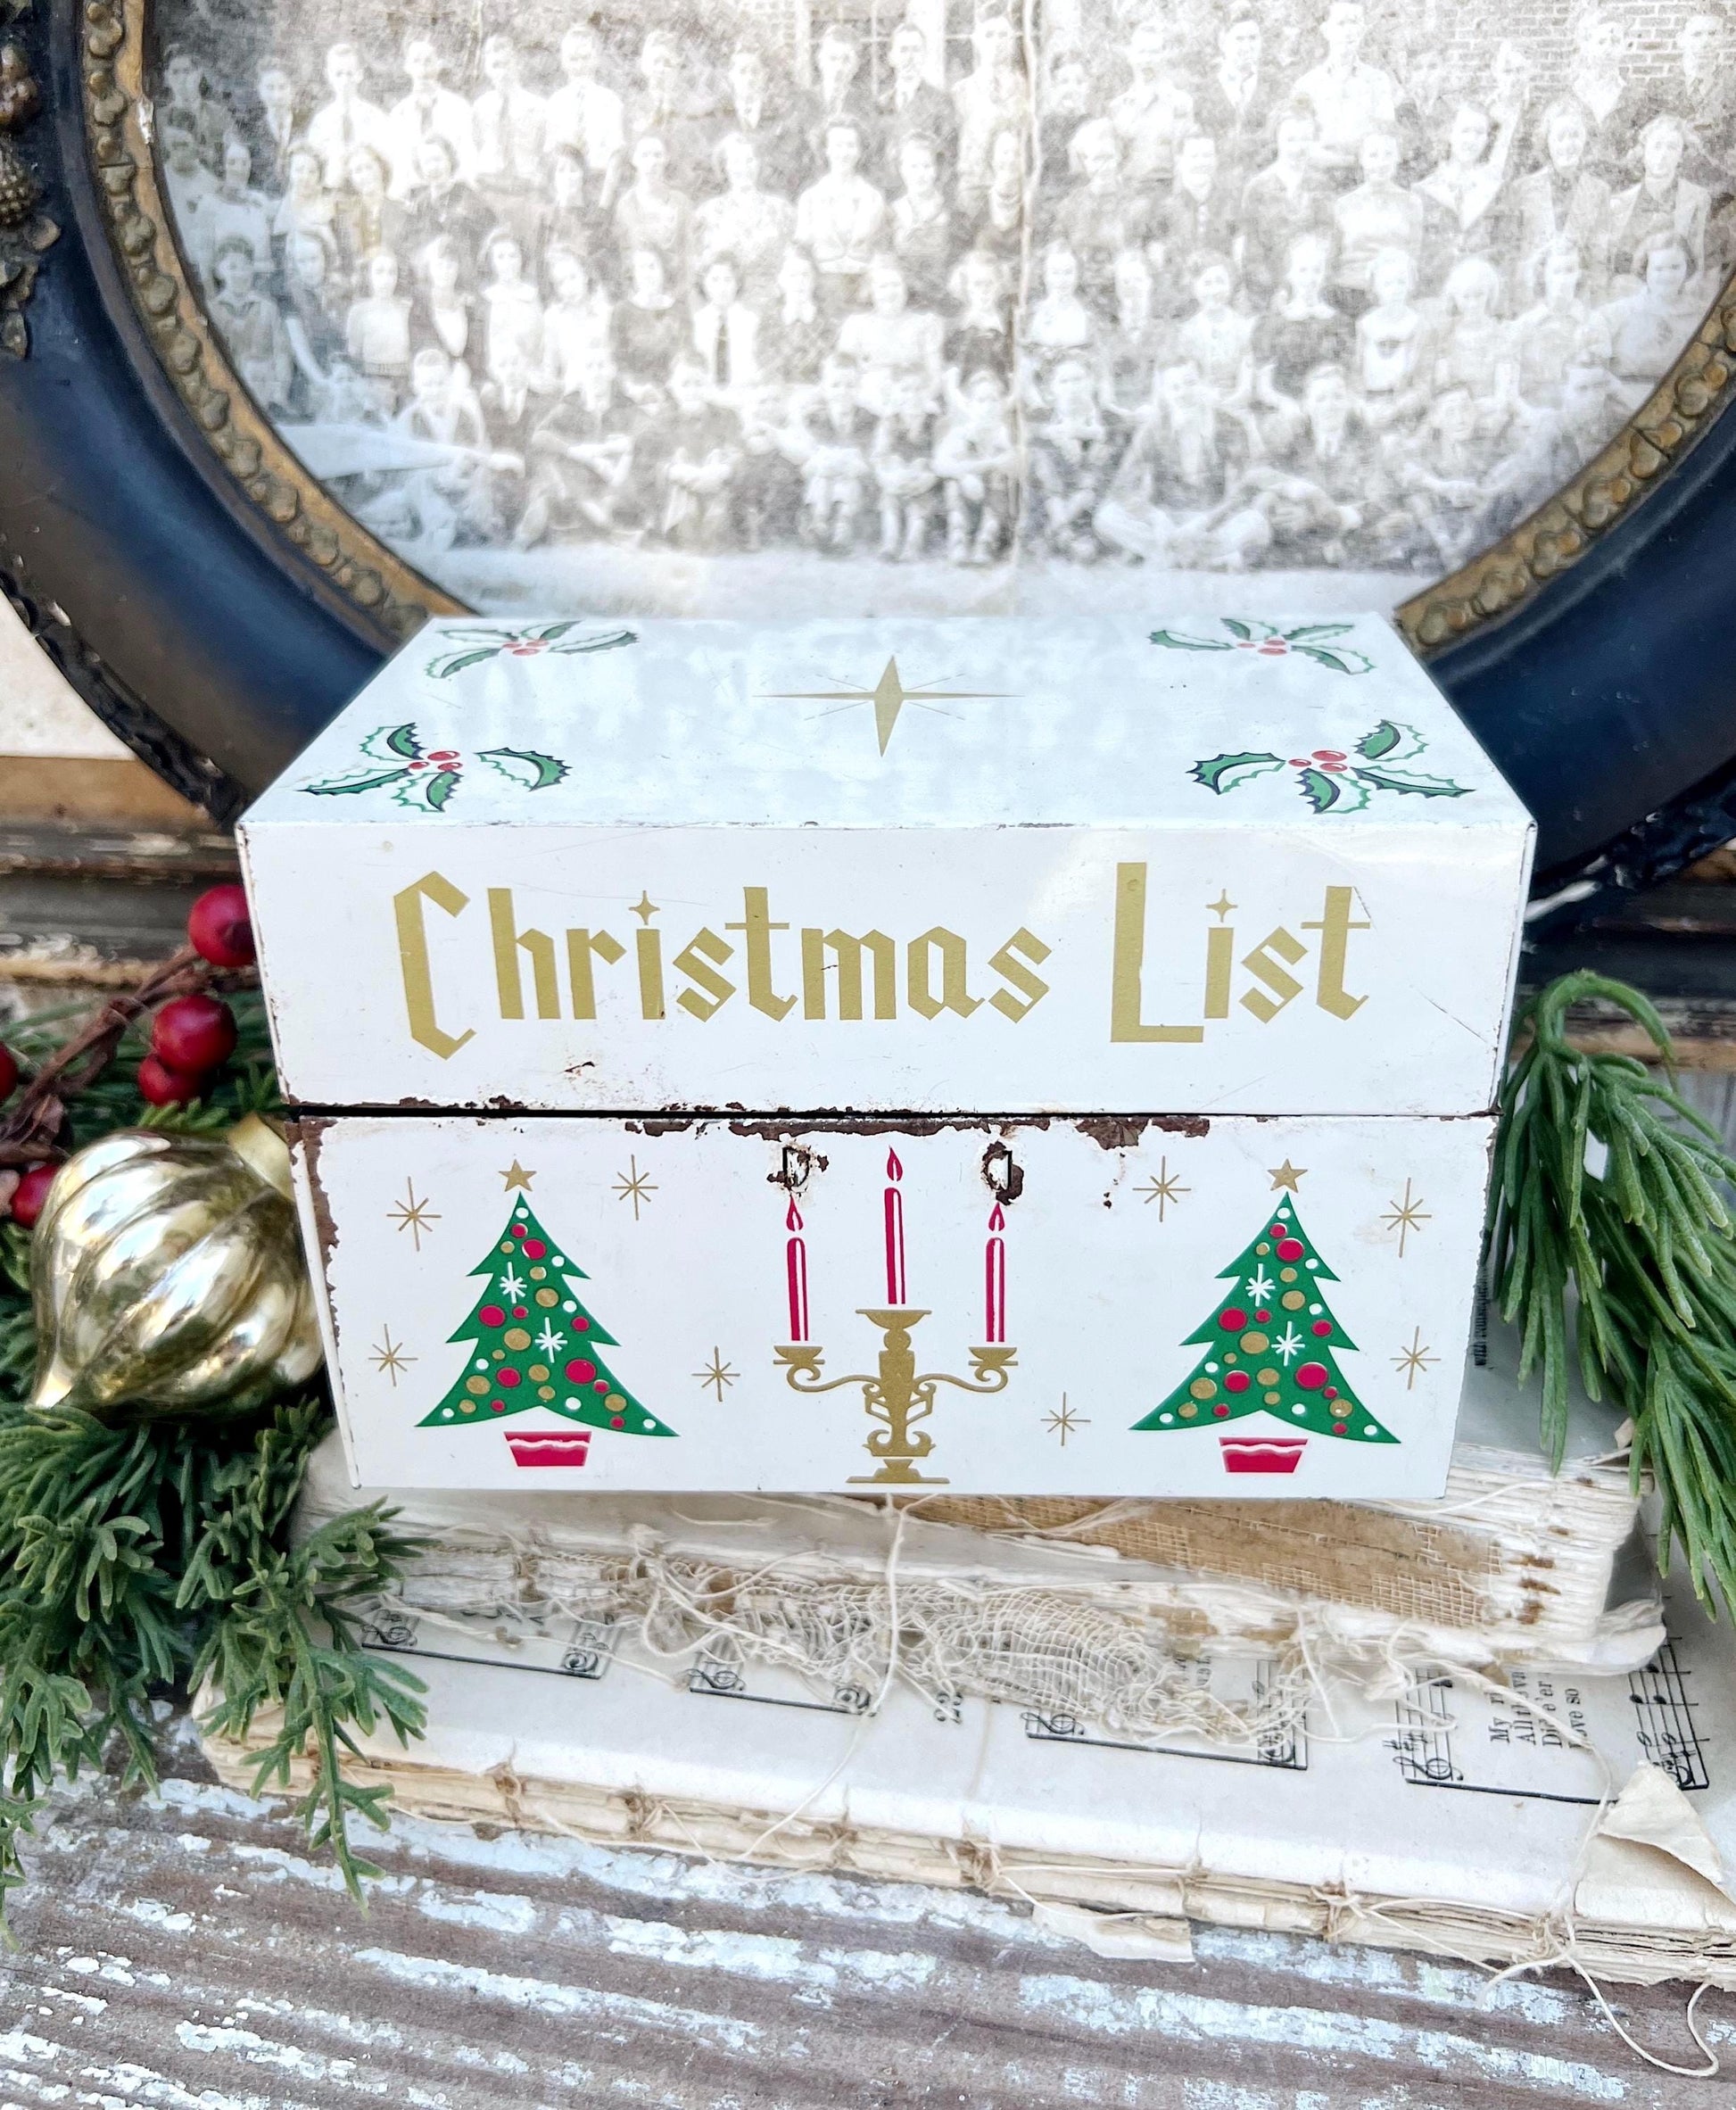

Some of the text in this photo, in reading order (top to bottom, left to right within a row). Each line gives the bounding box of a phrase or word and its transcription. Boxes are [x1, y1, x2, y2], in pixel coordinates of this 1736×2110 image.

[393, 861, 1372, 1061] Christmas List
[1565, 1688, 1582, 1705] so
[1488, 1717, 1514, 1744] My
[1512, 1720, 1536, 1746] All
